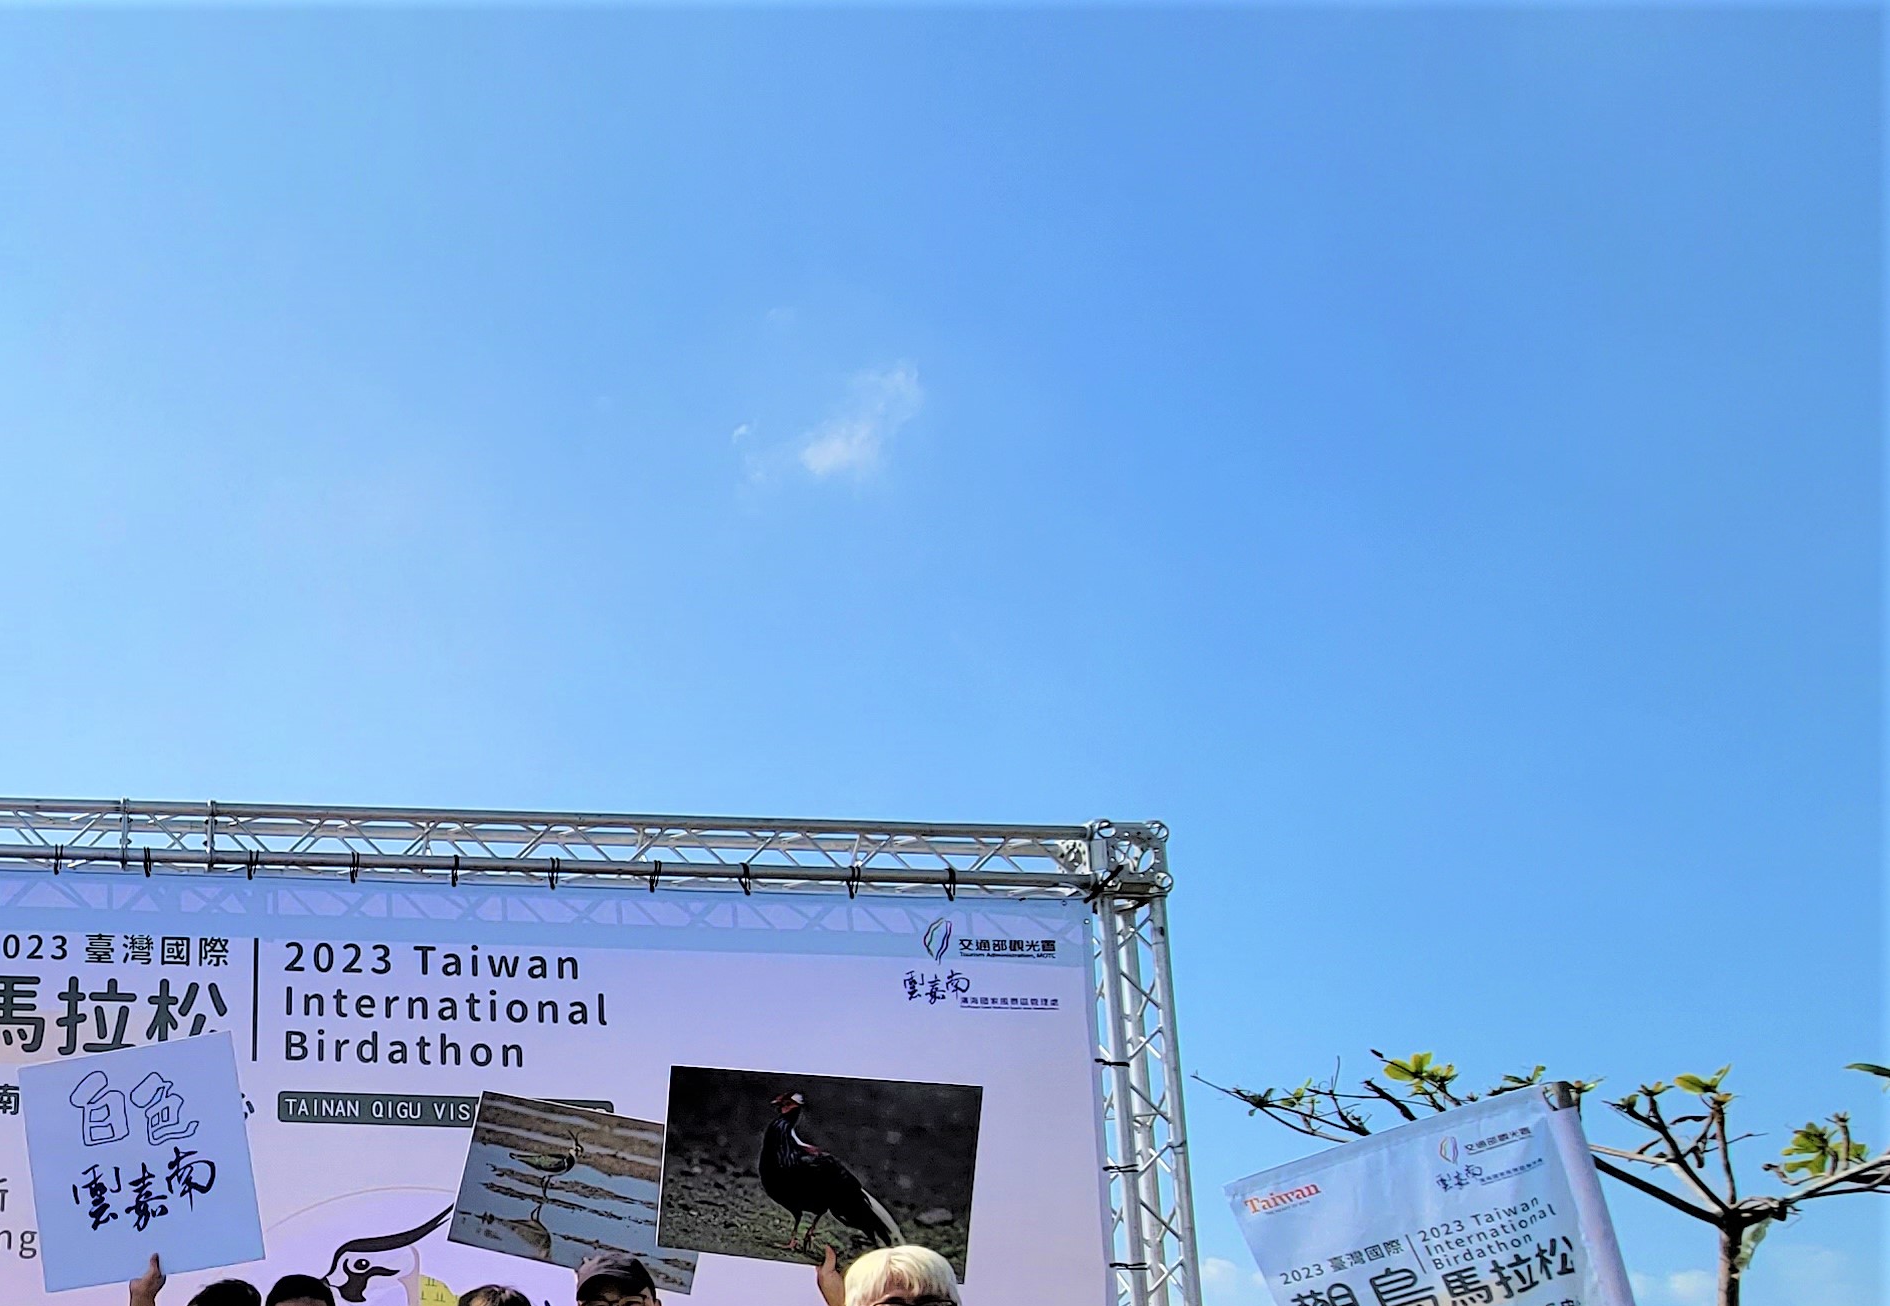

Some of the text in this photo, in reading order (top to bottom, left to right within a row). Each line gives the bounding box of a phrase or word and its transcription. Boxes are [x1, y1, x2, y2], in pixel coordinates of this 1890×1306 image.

[84, 933, 230, 967] 臺灣國際
[284, 942, 580, 980] 2023 Taiwan
[285, 986, 608, 1026] International
[285, 1029, 524, 1067] Birdathon
[69, 1070, 200, 1146] 白色
[284, 1098, 360, 1118] TAINAN
[371, 1100, 422, 1120] QIGU
[1243, 1183, 1322, 1215] Taiwan
[1417, 1197, 1540, 1242] 2023 Taiwan
[1424, 1203, 1557, 1256] International
[1279, 1238, 1405, 1285] 2023 臺灣國際
[1432, 1233, 1533, 1271] Birdathon
